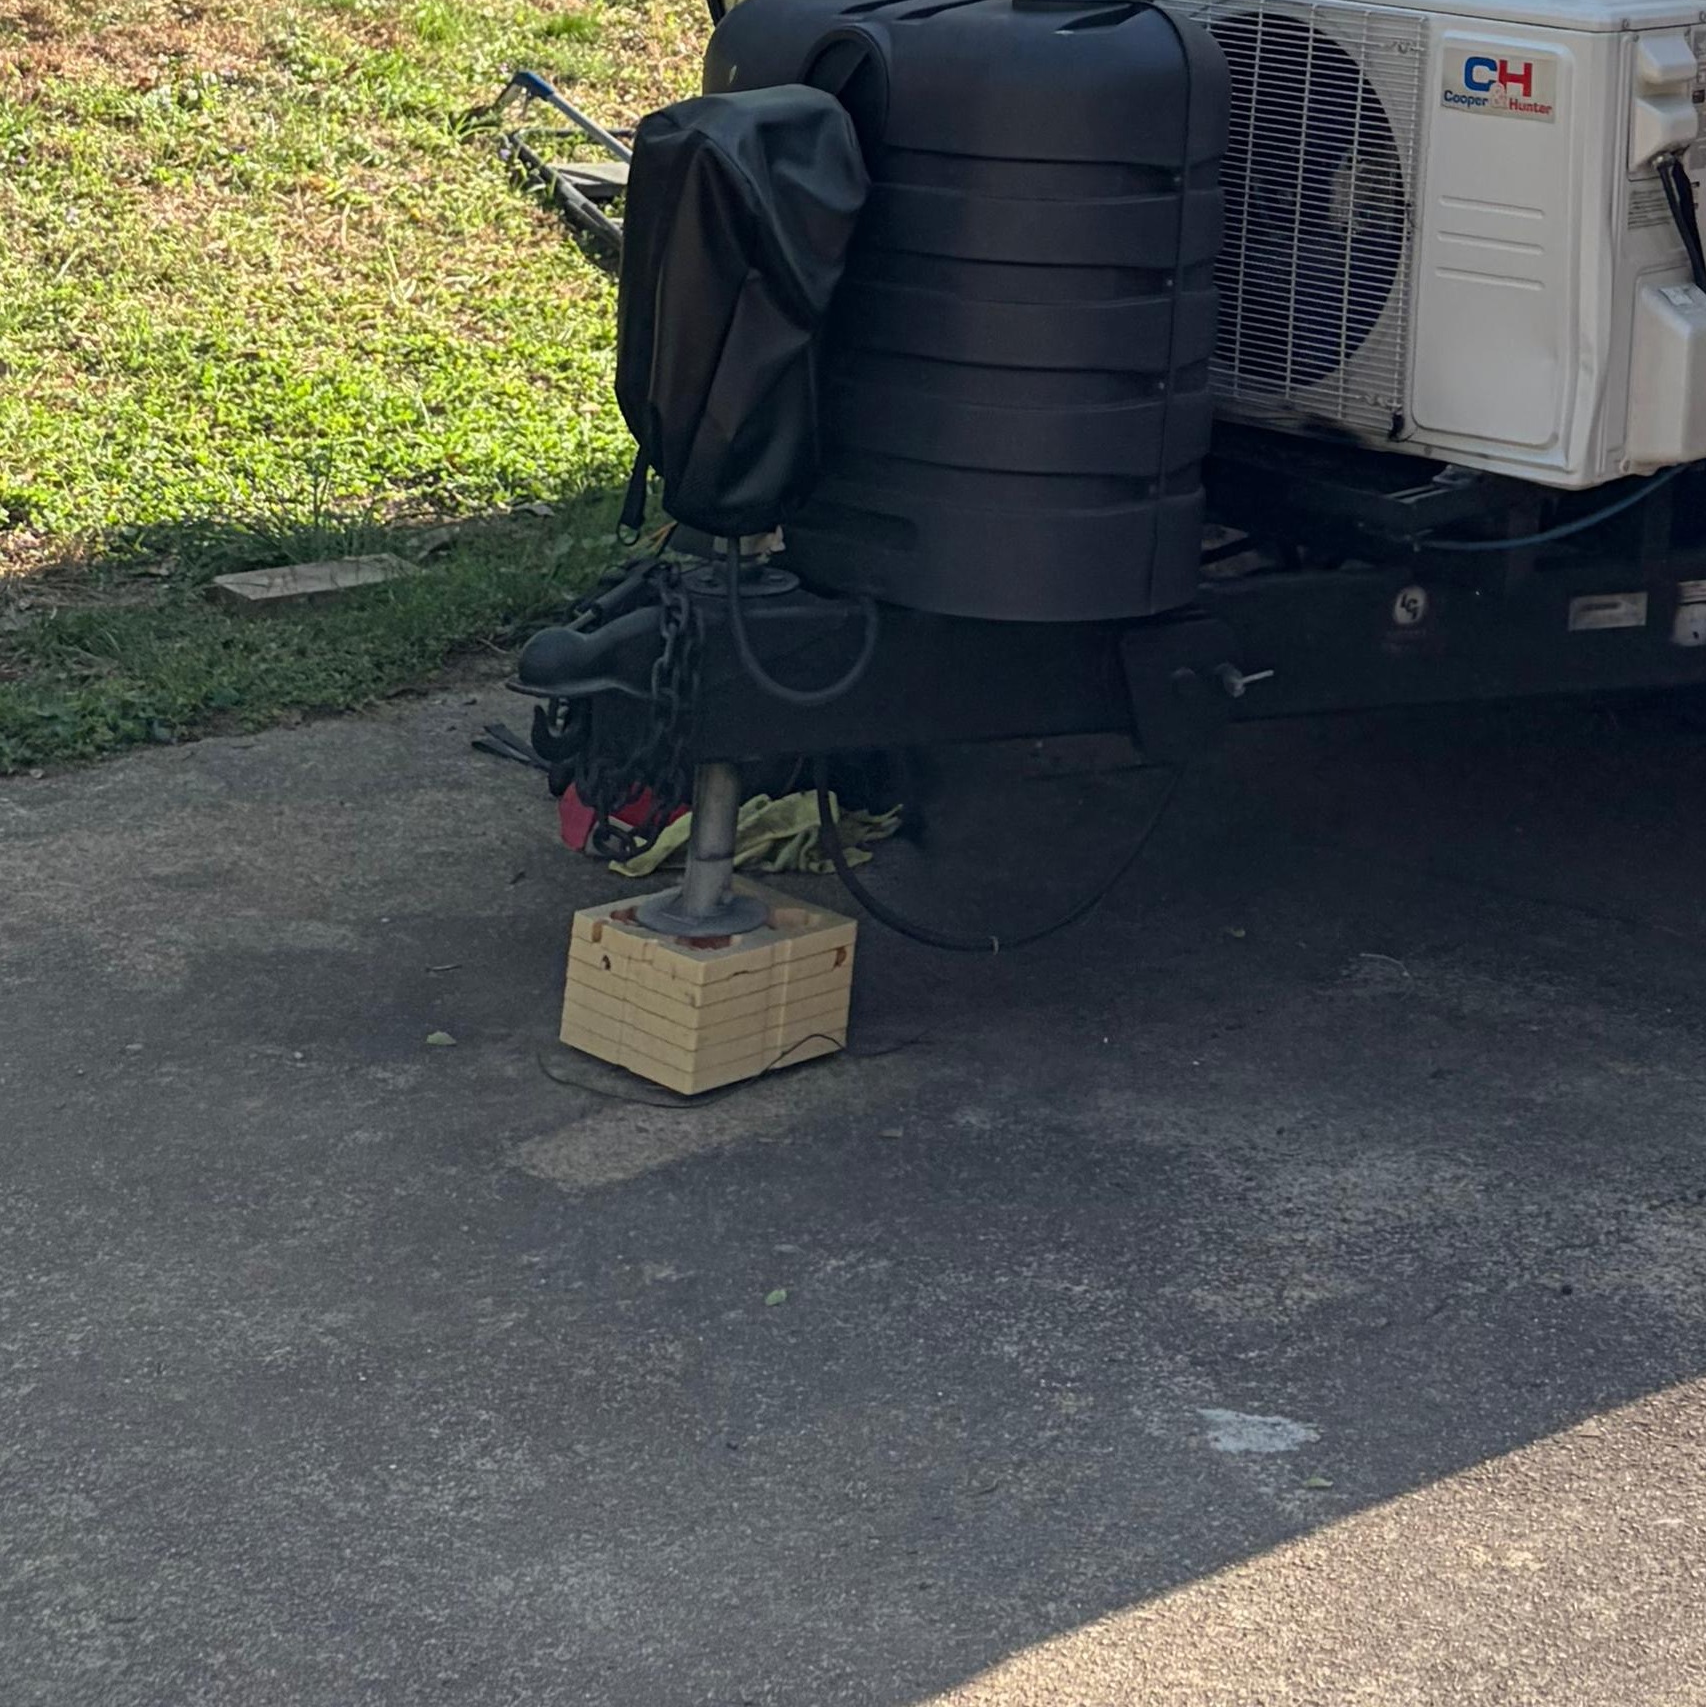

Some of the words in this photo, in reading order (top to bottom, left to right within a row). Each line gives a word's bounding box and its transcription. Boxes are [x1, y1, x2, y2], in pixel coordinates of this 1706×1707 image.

[1464, 55, 1533, 98] CH
[1443, 89, 1489, 108] Cooper
[1508, 97, 1553, 115] Hunter
